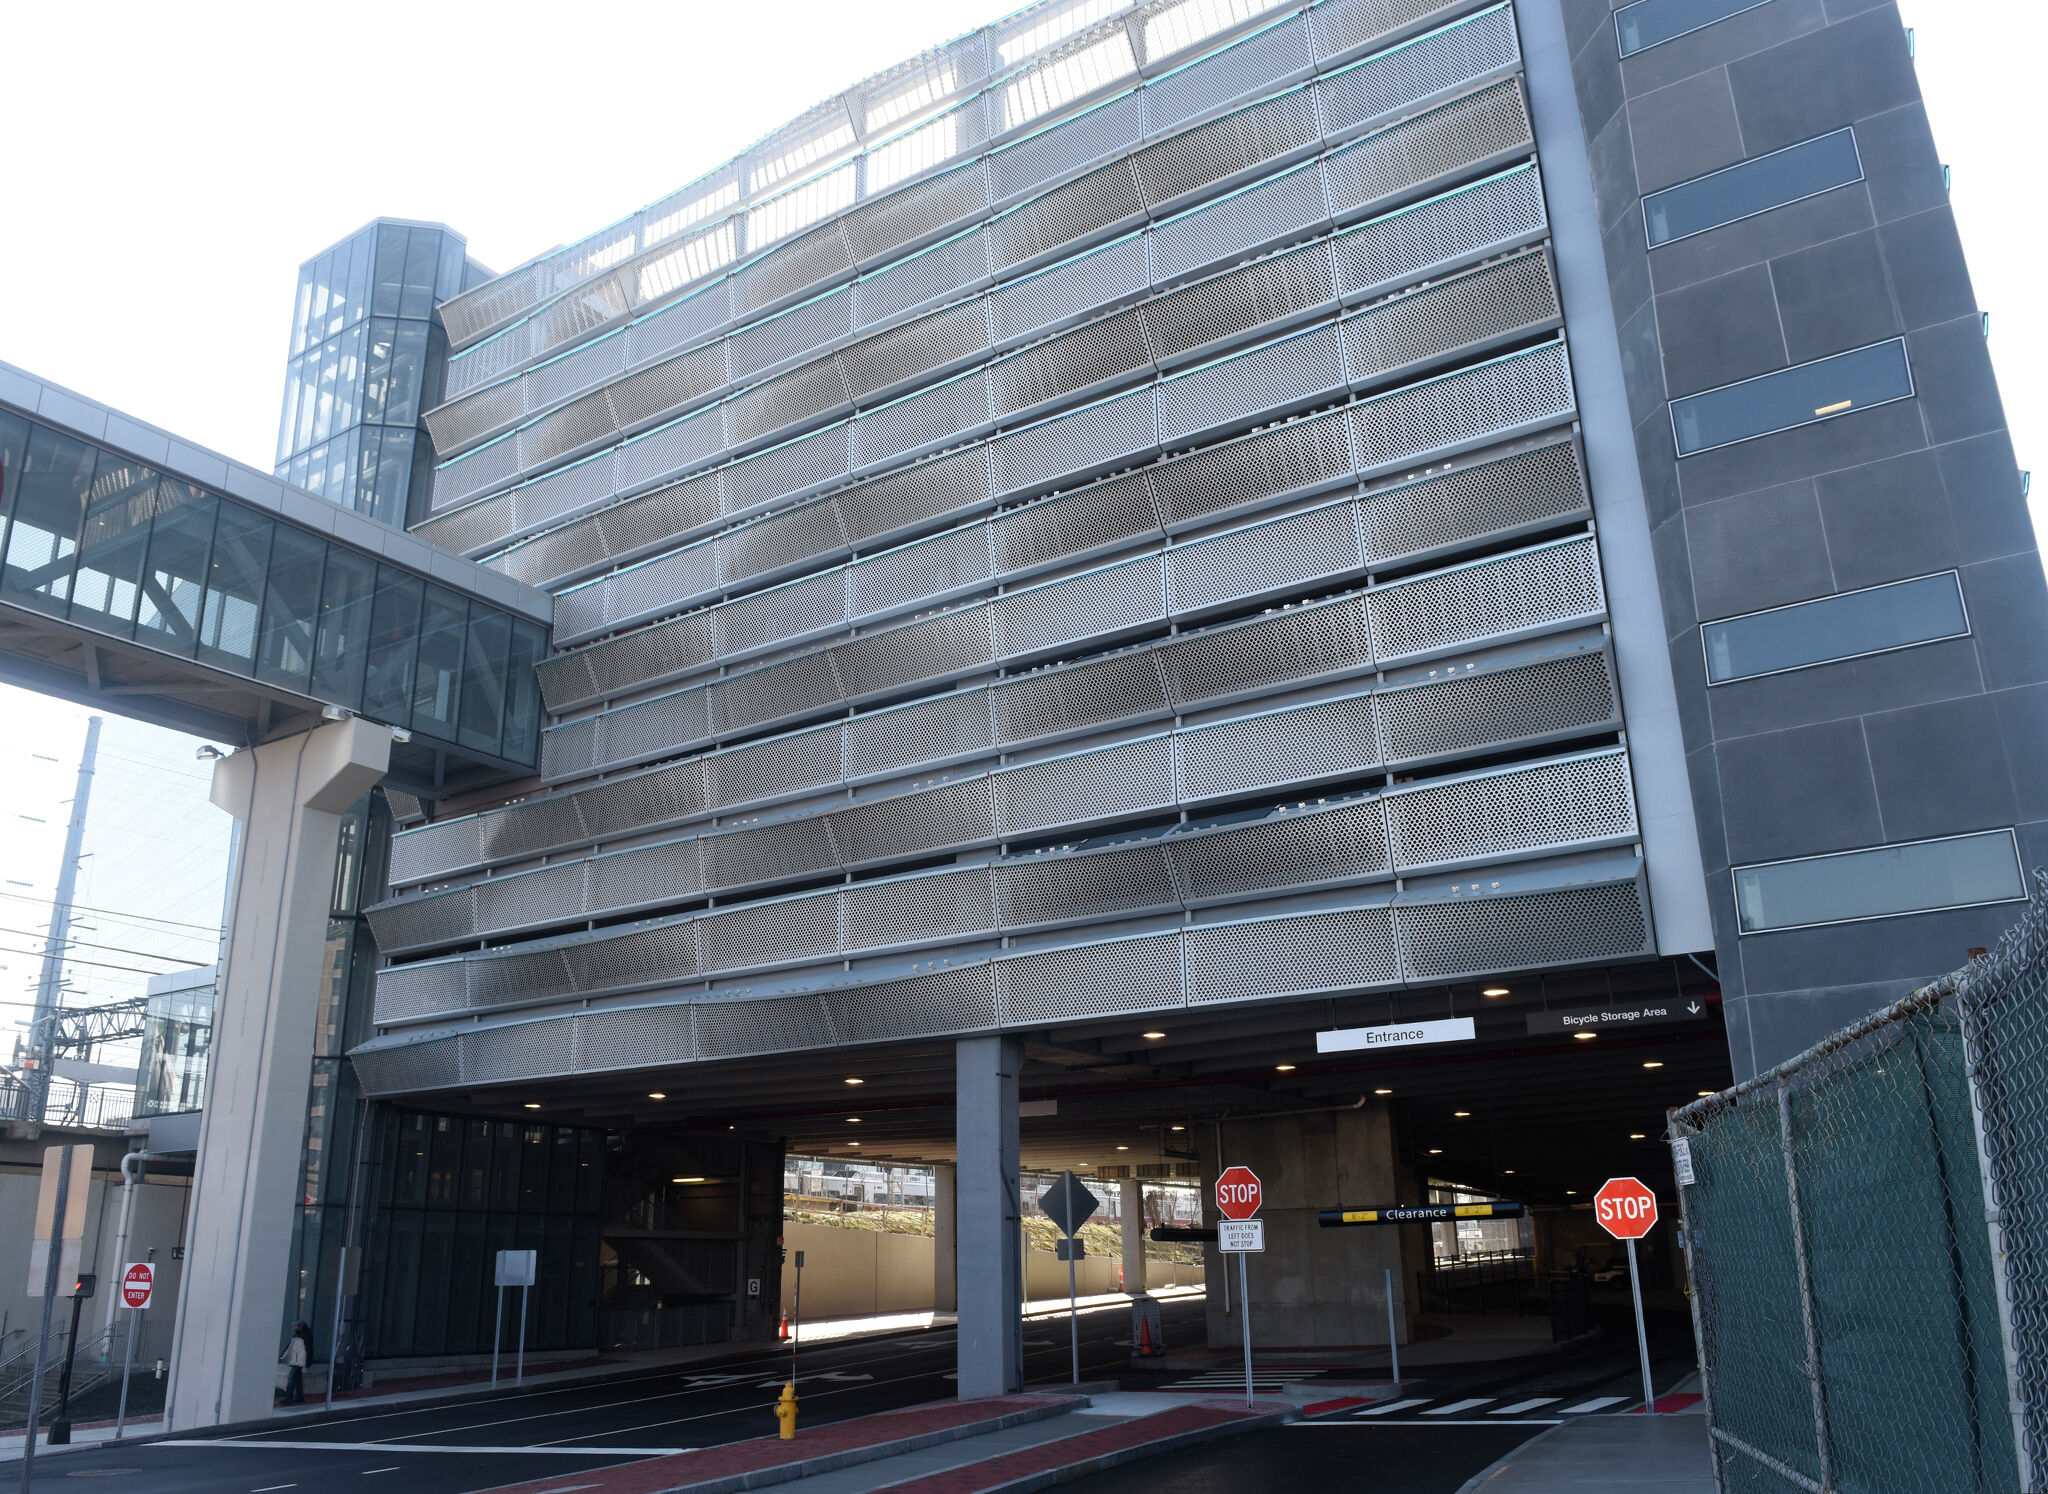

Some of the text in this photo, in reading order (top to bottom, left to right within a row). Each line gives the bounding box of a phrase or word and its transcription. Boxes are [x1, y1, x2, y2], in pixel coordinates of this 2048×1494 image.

[1563, 1008, 1668, 1026] Bicycle Storage Area
[1366, 1030, 1424, 1044] Entrance
[1220, 1183, 1258, 1203] STOP
[1385, 1208, 1447, 1220] Clearance
[1600, 1196, 1651, 1220] STOP
[750, 1280, 758, 1293] G
[128, 1291, 145, 1299] ENTER
